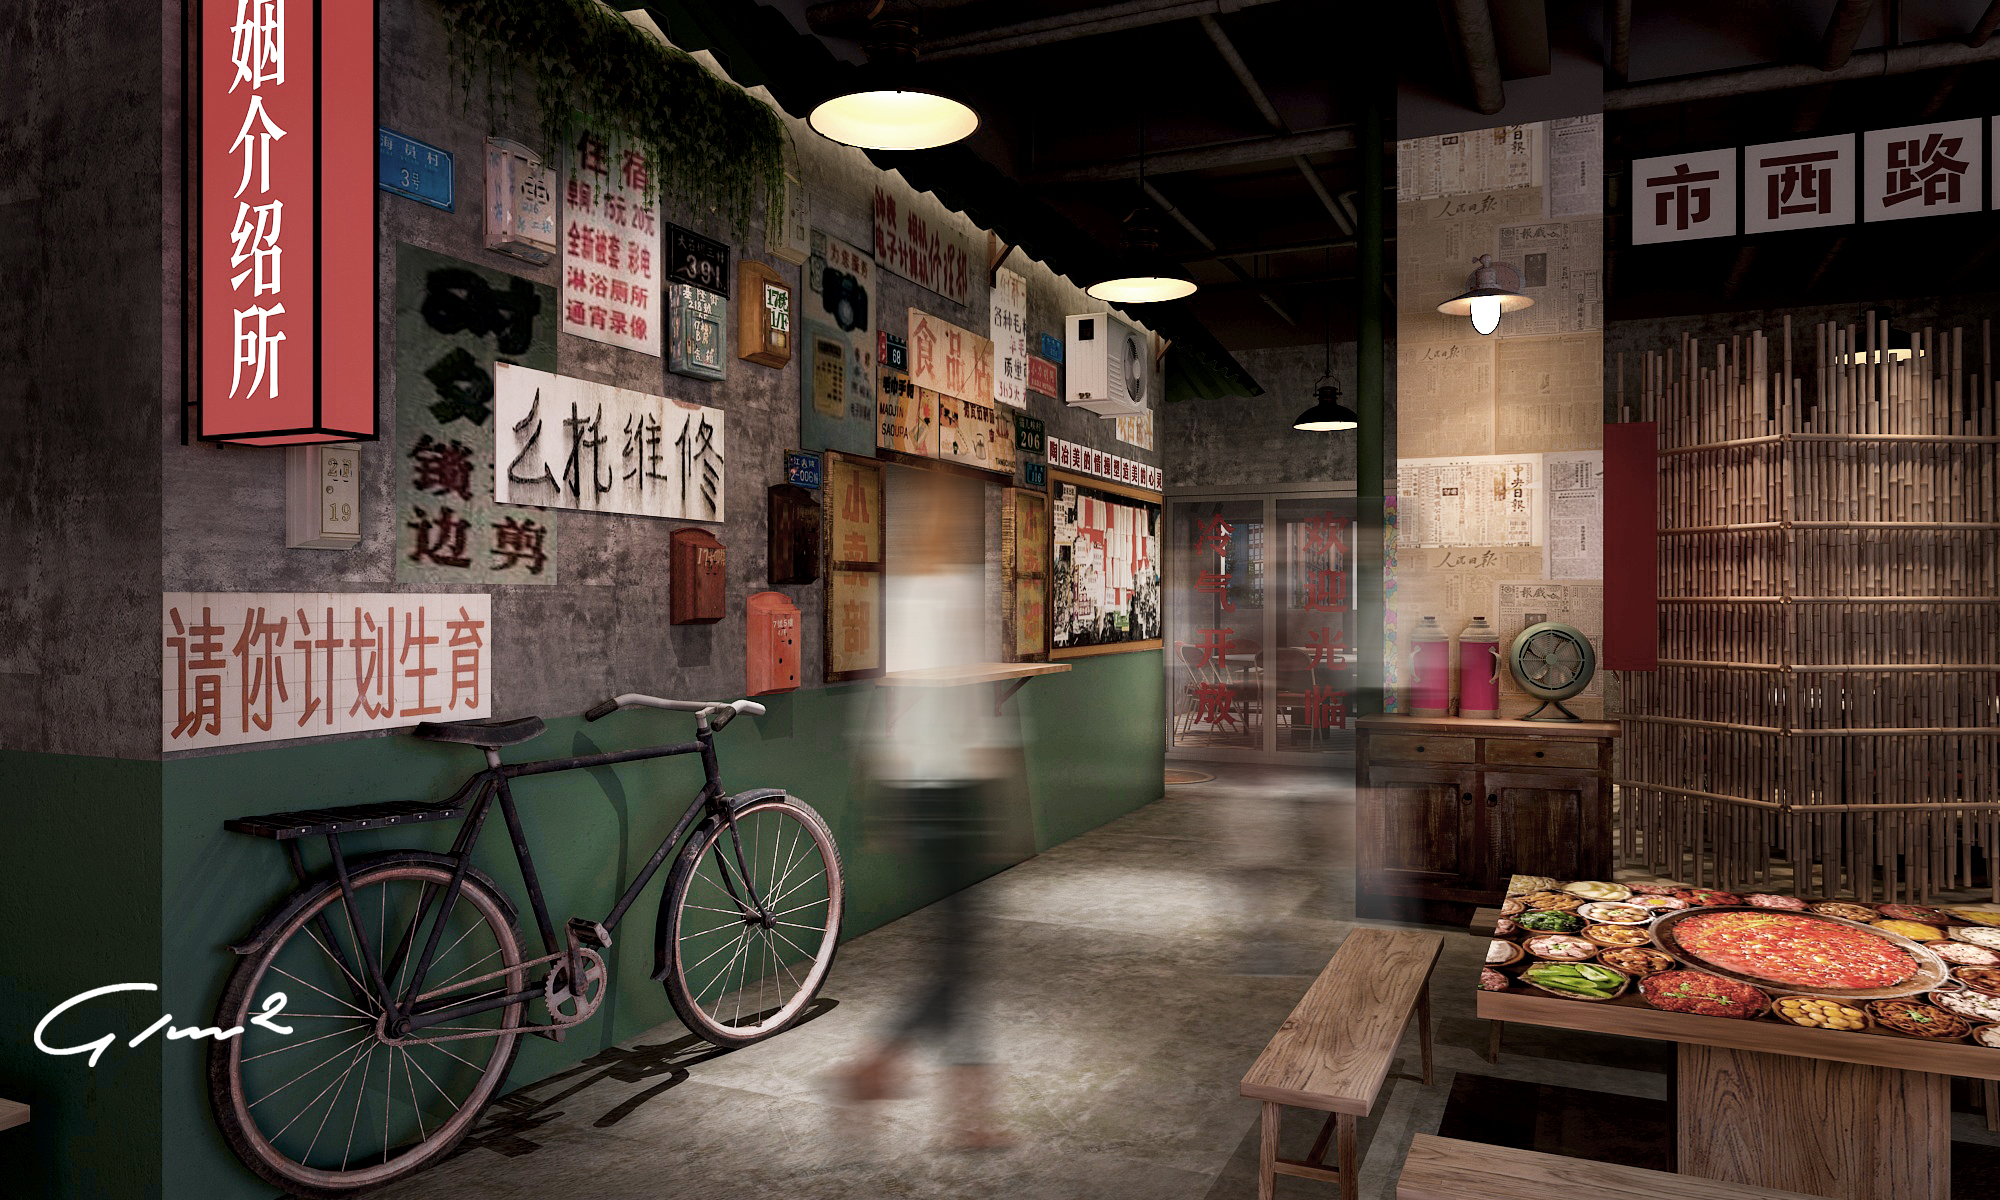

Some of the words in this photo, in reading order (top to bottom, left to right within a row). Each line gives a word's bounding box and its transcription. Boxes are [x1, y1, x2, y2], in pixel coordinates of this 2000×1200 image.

[401, 168, 420, 190] 3号
[577, 129, 649, 193] 住宿
[1647, 133, 1970, 230] 市西路
[228, 0, 287, 399] 姻介绍所
[567, 266, 648, 310] 淋浴厕所
[686, 254, 721, 289] 391
[566, 299, 647, 341] 通宵录像
[892, 348, 901, 365] 68
[913, 317, 990, 403] 食品店
[1021, 430, 1040, 450] 206
[1049, 440, 1162, 489] 陶冶美的情操塑造美的心灵
[329, 503, 352, 522] 19
[1194, 513, 1237, 725] 冷气开放
[1303, 511, 1348, 730] 欢迎光临
[166, 605, 485, 740] 请你计划生育
